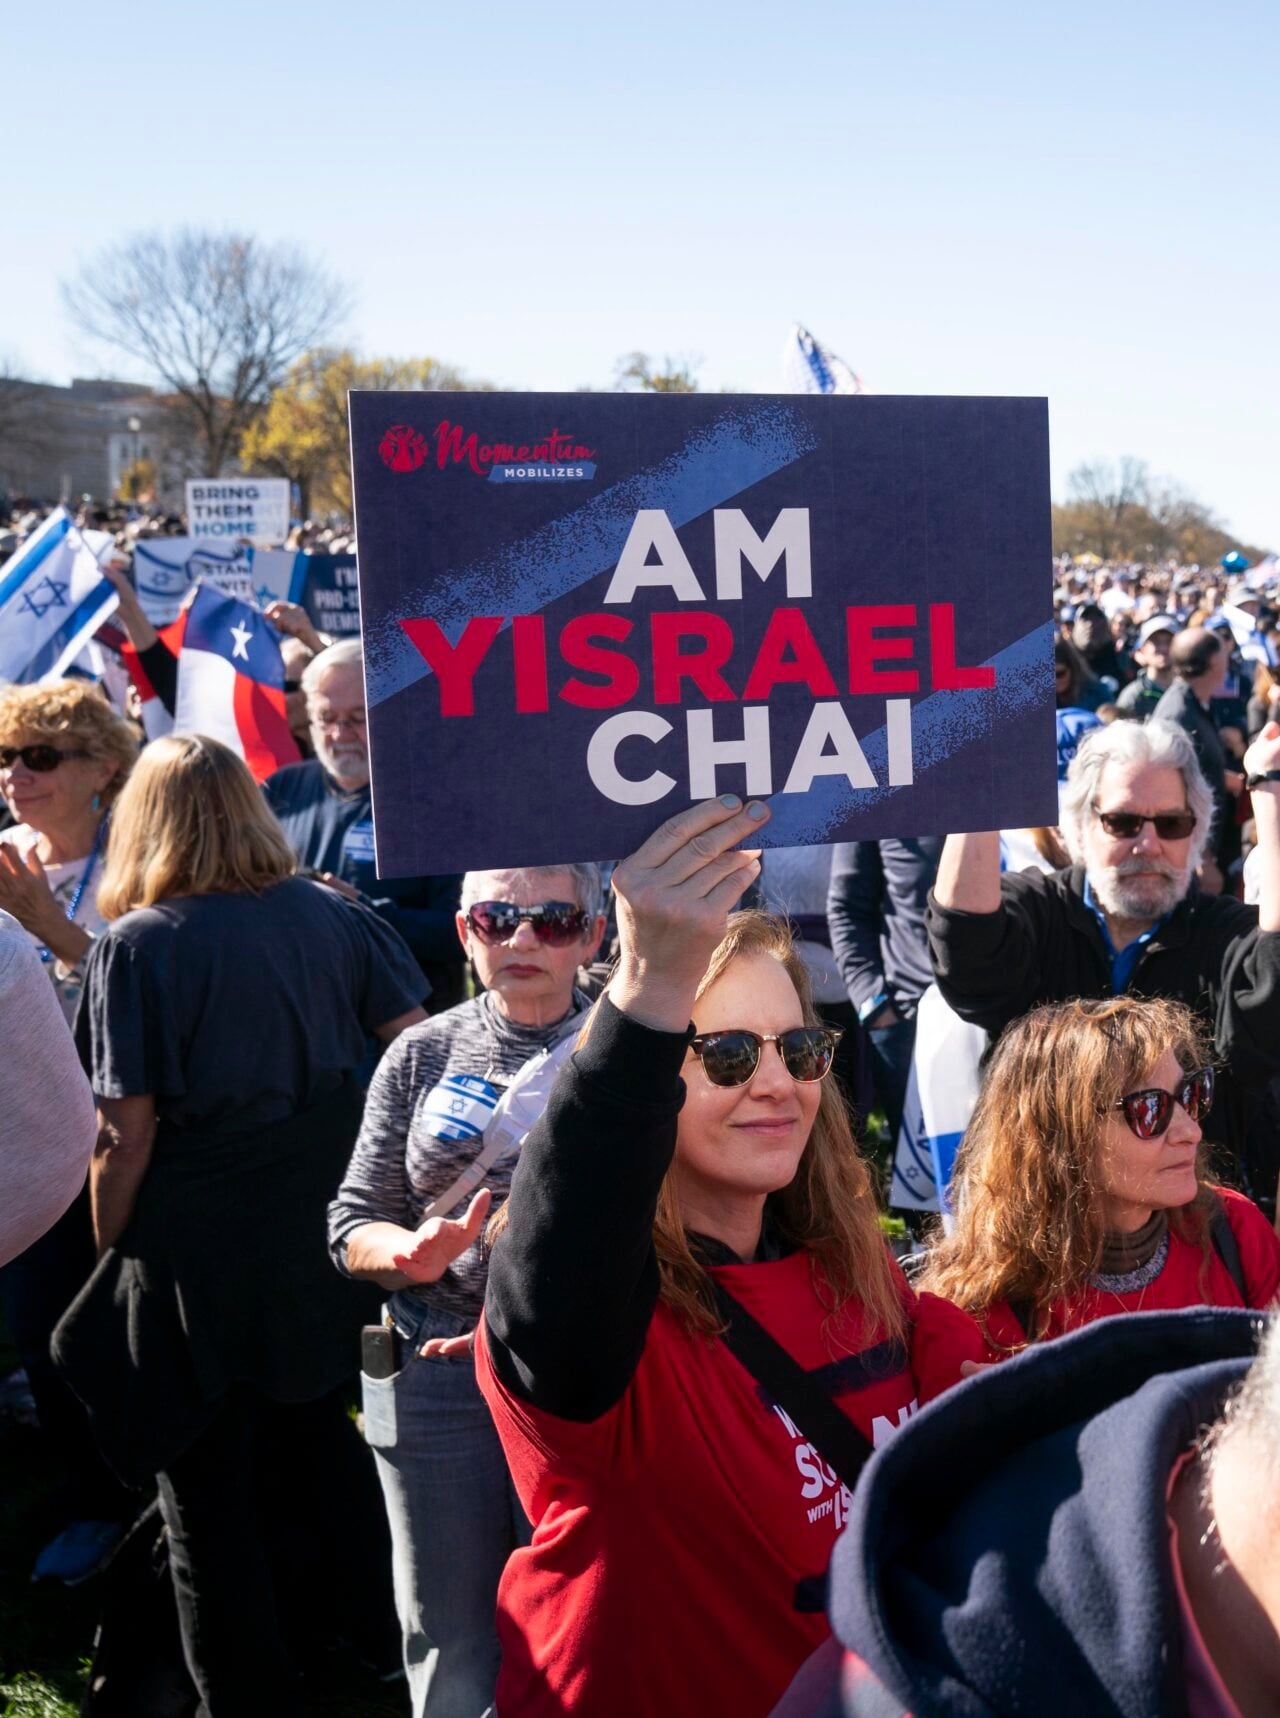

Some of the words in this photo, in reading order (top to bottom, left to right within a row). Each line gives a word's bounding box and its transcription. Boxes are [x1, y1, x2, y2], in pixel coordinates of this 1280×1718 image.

[432, 419, 597, 476] Momentum
[504, 467, 584, 478] MOBILIZES
[192, 484, 260, 500] BRING
[194, 504, 254, 518] THEM
[194, 522, 256, 537] HOME
[603, 507, 813, 604] AM
[399, 602, 997, 717] YISRAEL
[586, 698, 914, 806] CHAI
[807, 1498, 834, 1524] WITH
